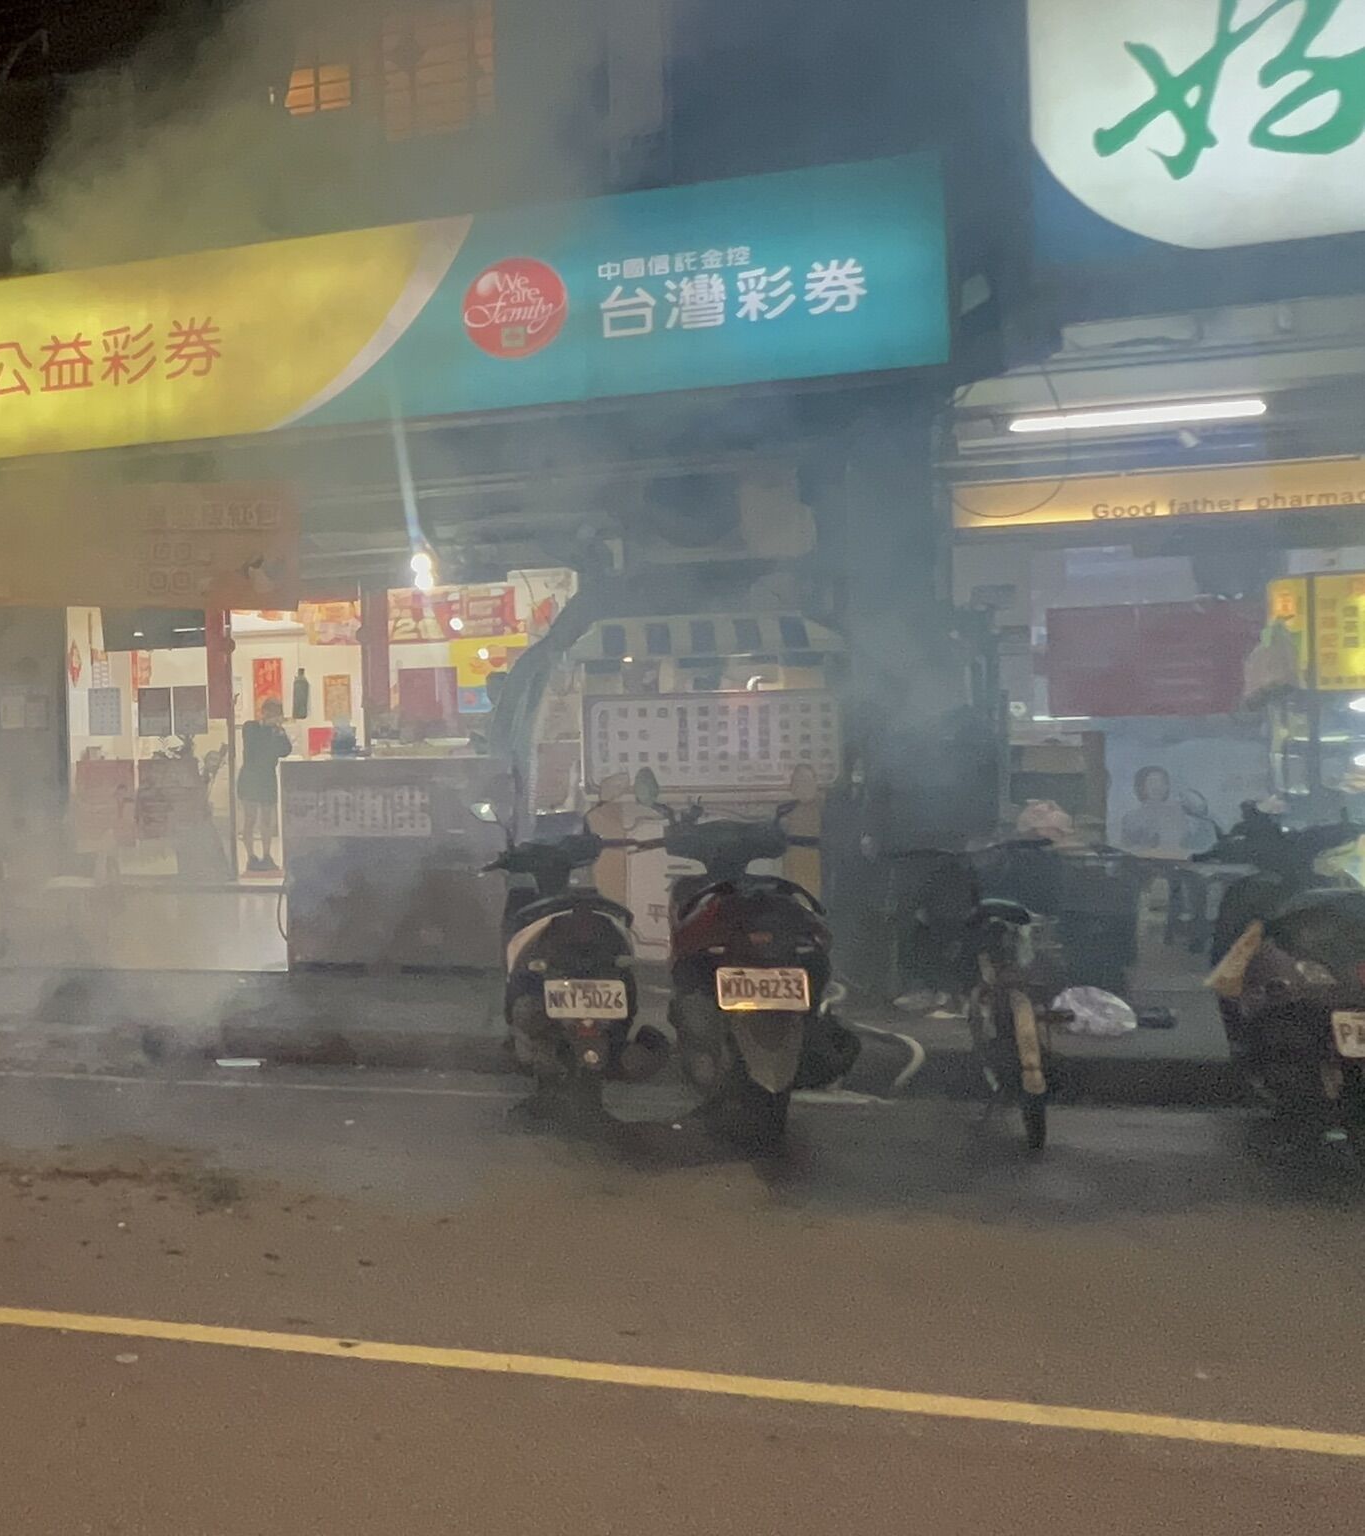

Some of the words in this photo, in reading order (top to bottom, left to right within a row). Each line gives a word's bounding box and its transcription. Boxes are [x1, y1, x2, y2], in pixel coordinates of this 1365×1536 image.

[598, 246, 751, 281] 中國信託金控
[495, 271, 529, 292] We
[510, 287, 540, 304] are
[600, 258, 867, 338] 台灣彩券
[464, 290, 554, 334] Family
[1092, 502, 1156, 519] Good
[1168, 498, 1241, 515] father
[720, 977, 805, 999] MXD-8233
[548, 989, 623, 1009] NKY-5026
